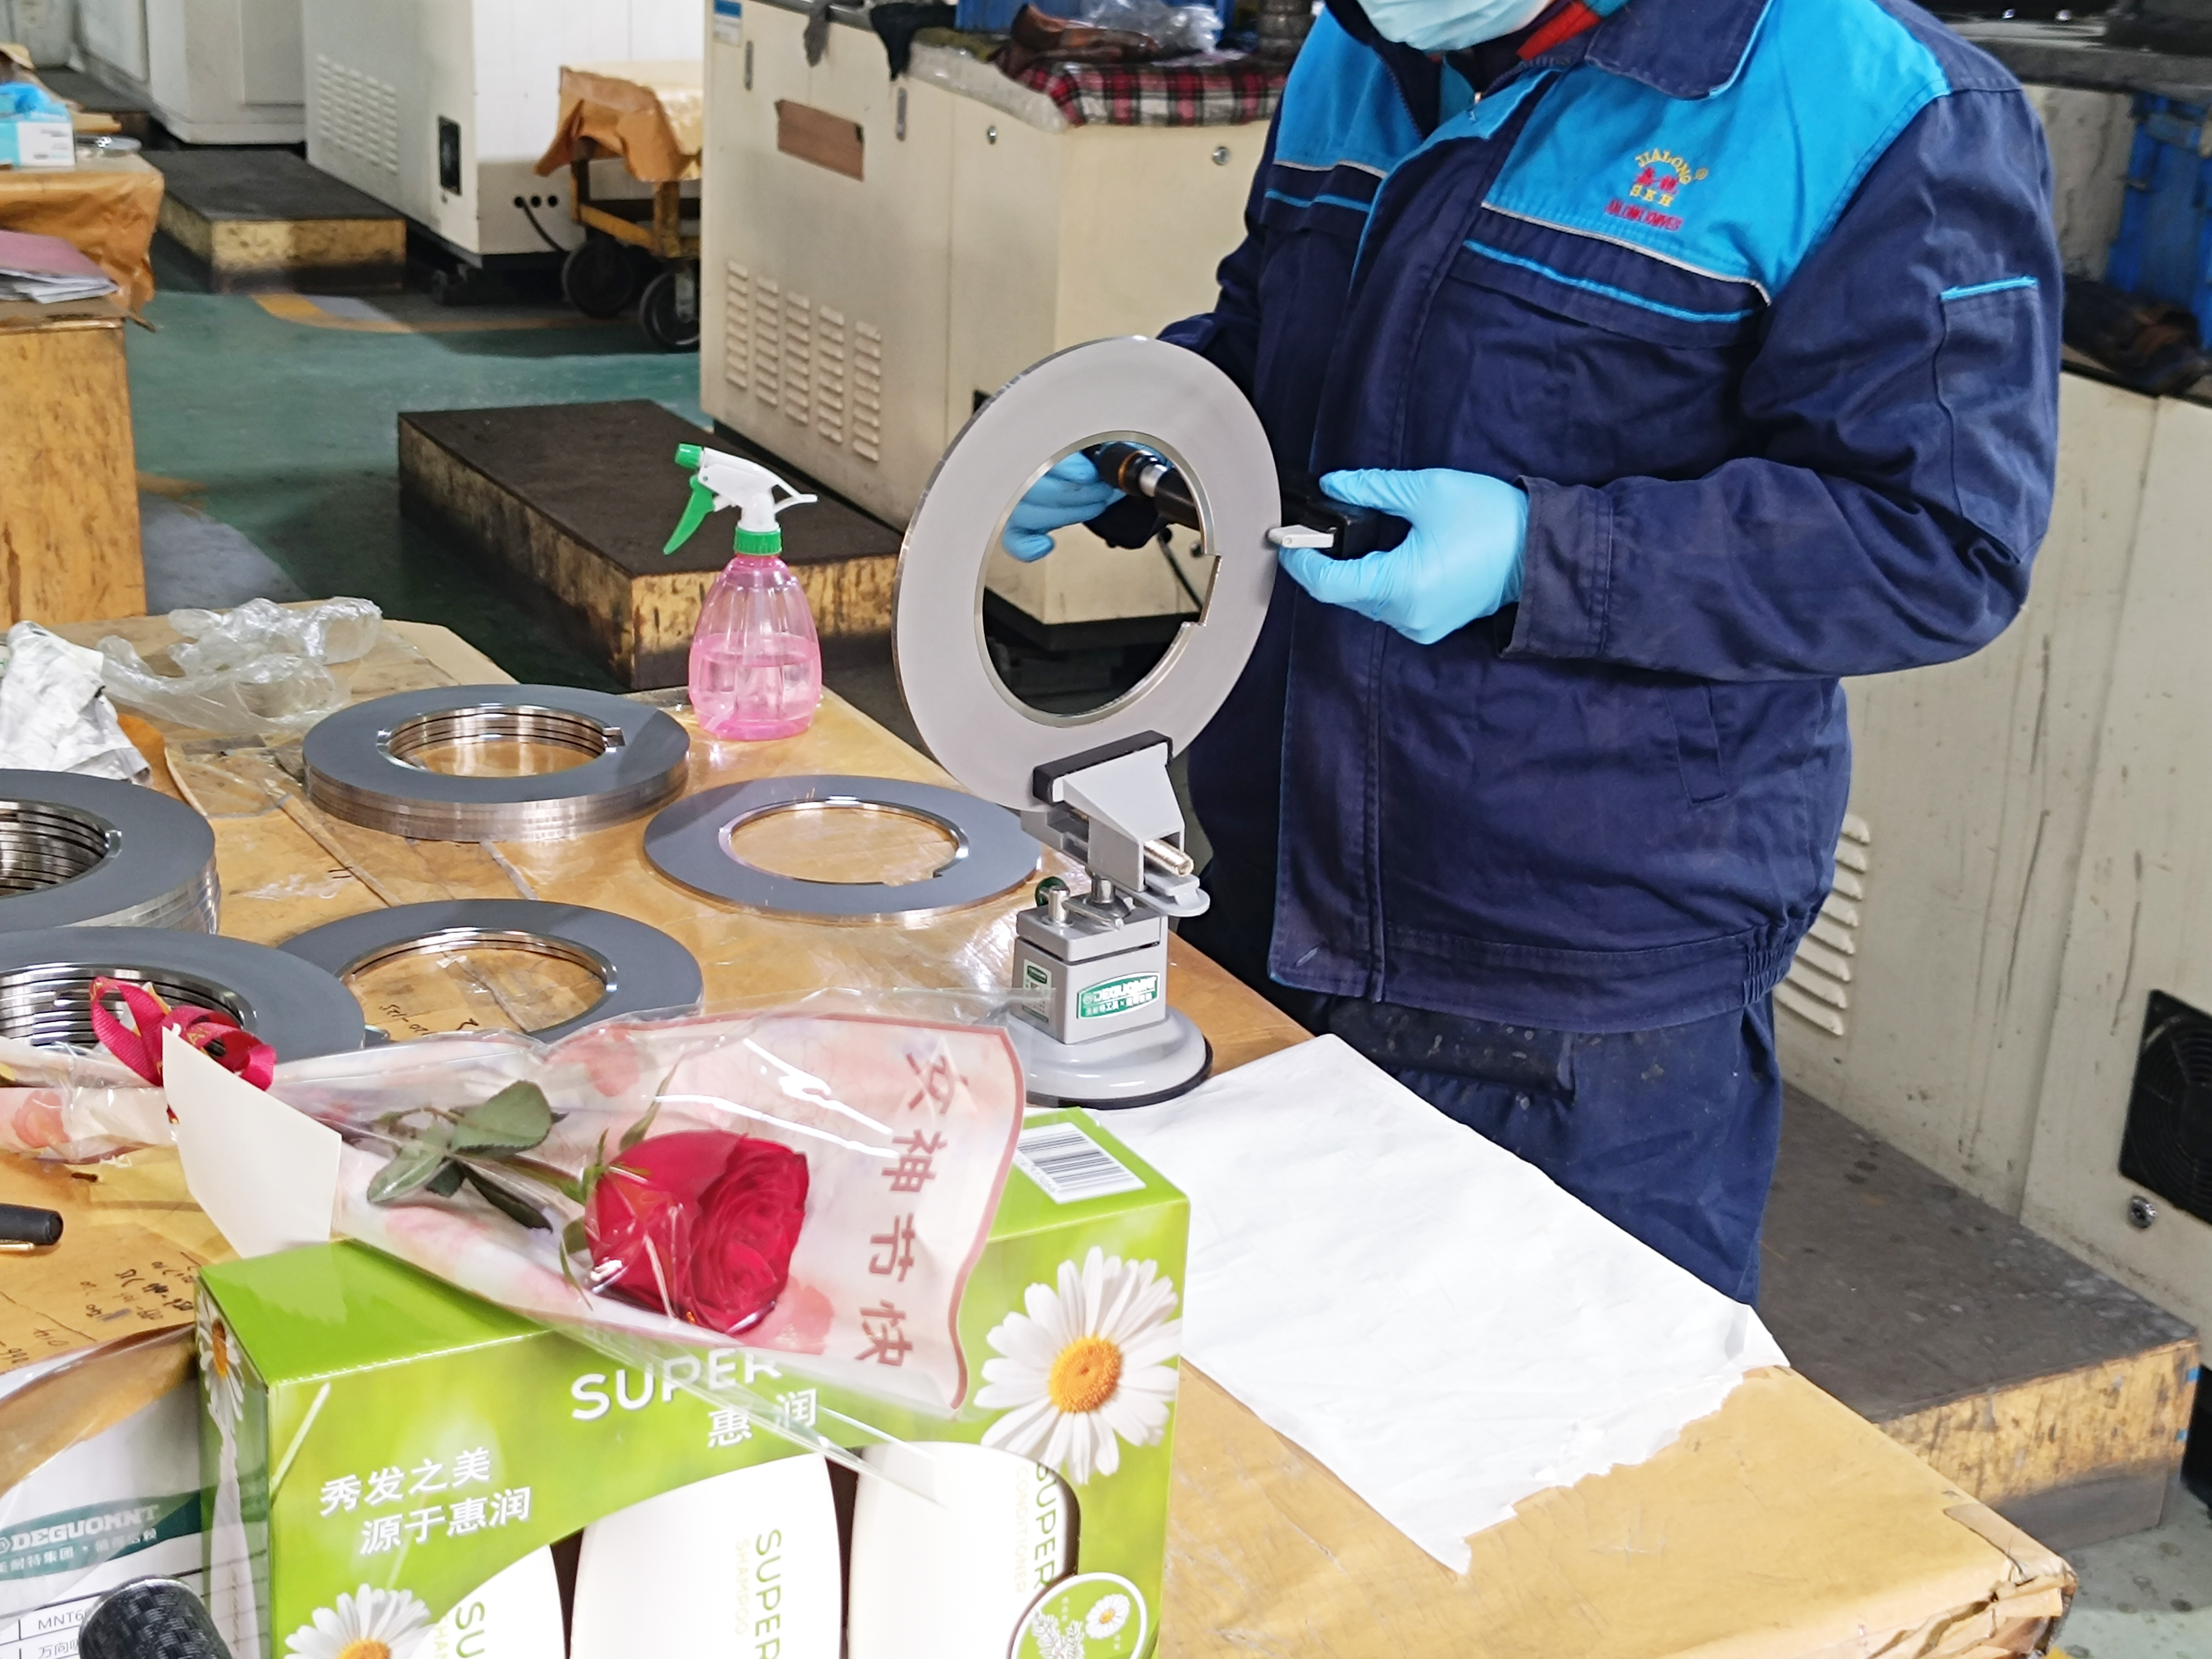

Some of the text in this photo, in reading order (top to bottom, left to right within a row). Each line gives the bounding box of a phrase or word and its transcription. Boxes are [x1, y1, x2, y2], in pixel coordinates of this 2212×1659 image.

[320, 1446, 491, 1516] 秀发之美
[360, 1486, 531, 1555] 源于惠润
[1015, 1466, 1029, 1594] CONDITIONER
[735, 1539, 750, 1635] SHAMPOO
[755, 1529, 782, 1659] SUPER
